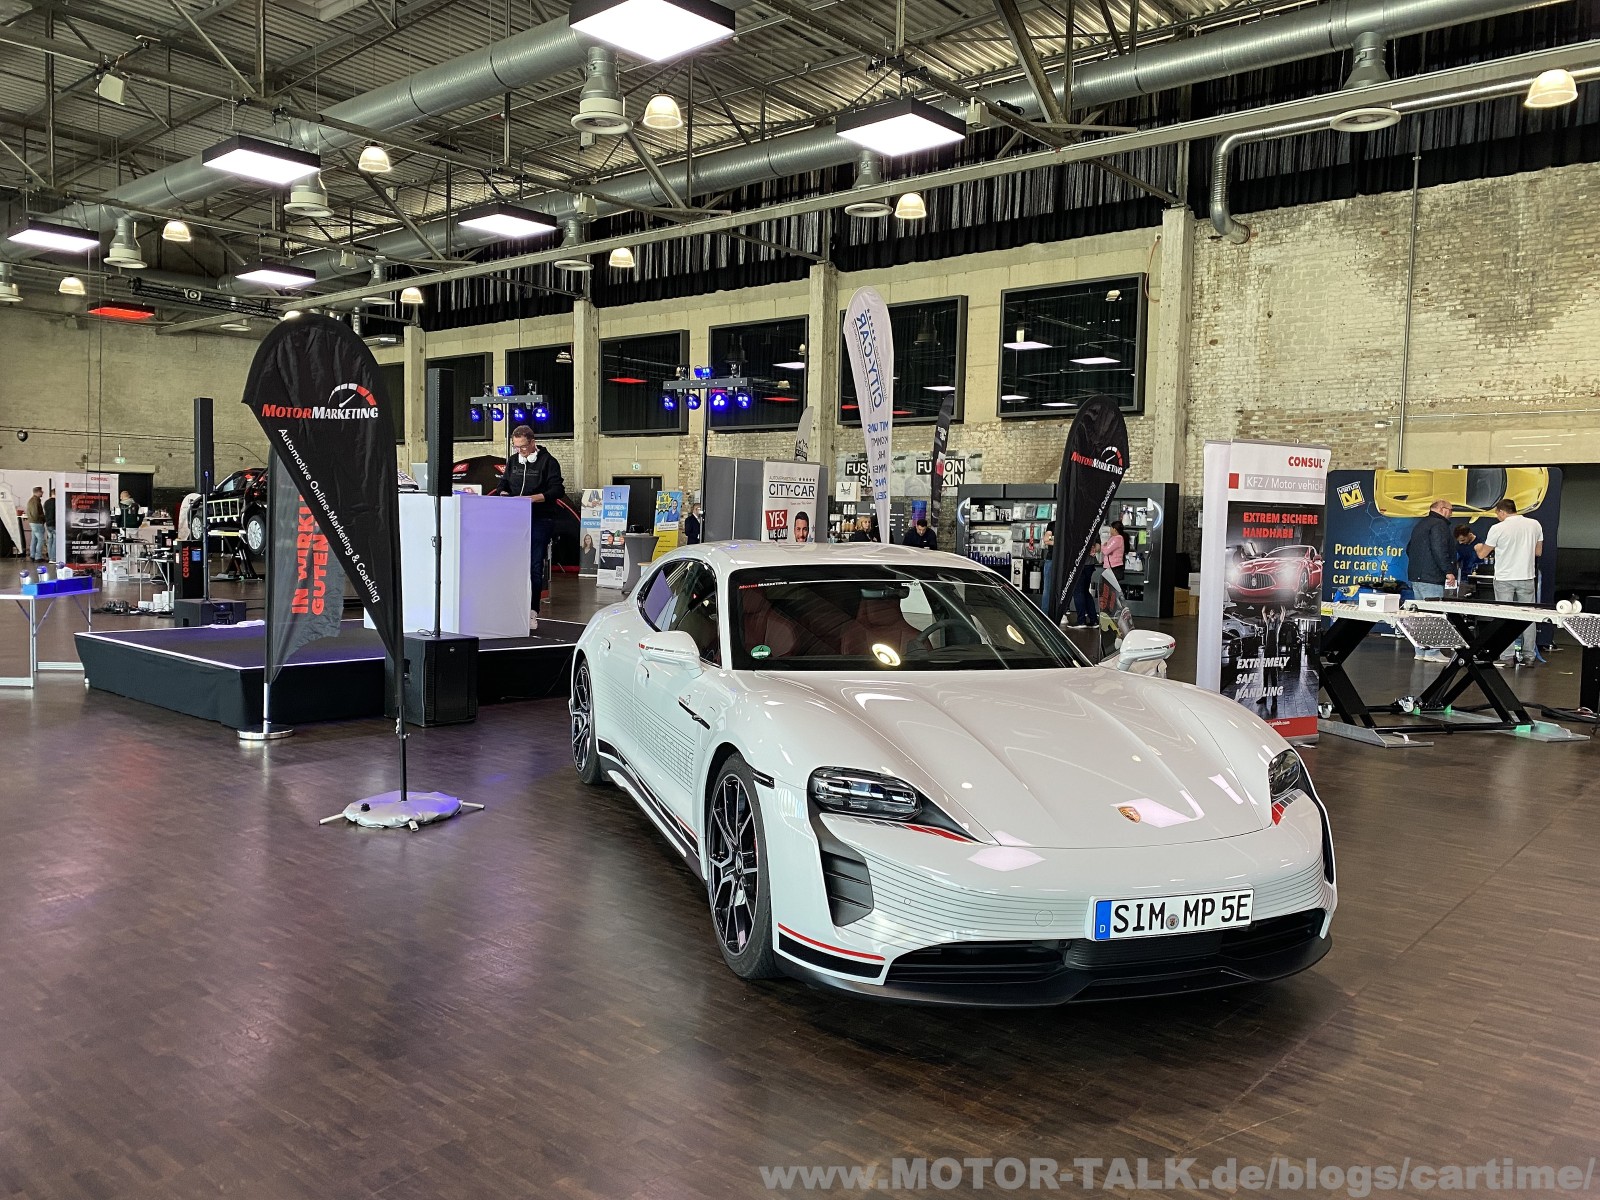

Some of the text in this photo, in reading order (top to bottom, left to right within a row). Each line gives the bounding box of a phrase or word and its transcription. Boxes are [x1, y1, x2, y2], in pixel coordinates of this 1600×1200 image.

[262, 404, 378, 419] MOTORMARKETING
[1288, 456, 1323, 468] CONSUL
[769, 484, 815, 497] CITY-CAR
[1246, 477, 1263, 488] KFZ
[1271, 479, 1296, 490] Motor
[278, 429, 381, 604] Automotive Online-Marketing & Coaching
[768, 511, 785, 528] YES
[1243, 512, 1318, 525] EXTREM SICHERE
[1334, 543, 1404, 557] Products for
[182, 546, 190, 577] CONSUL
[1333, 560, 1389, 571] car care &
[312, 534, 329, 615] GUTEN
[1332, 574, 1351, 584] car
[292, 588, 309, 614] IN
[1236, 656, 1290, 669] EXTREMELY
[1235, 672, 1259, 685] SAFE
[1235, 686, 1284, 700] HANDLING
[1099, 894, 1251, 933] D SIM MP 5E
